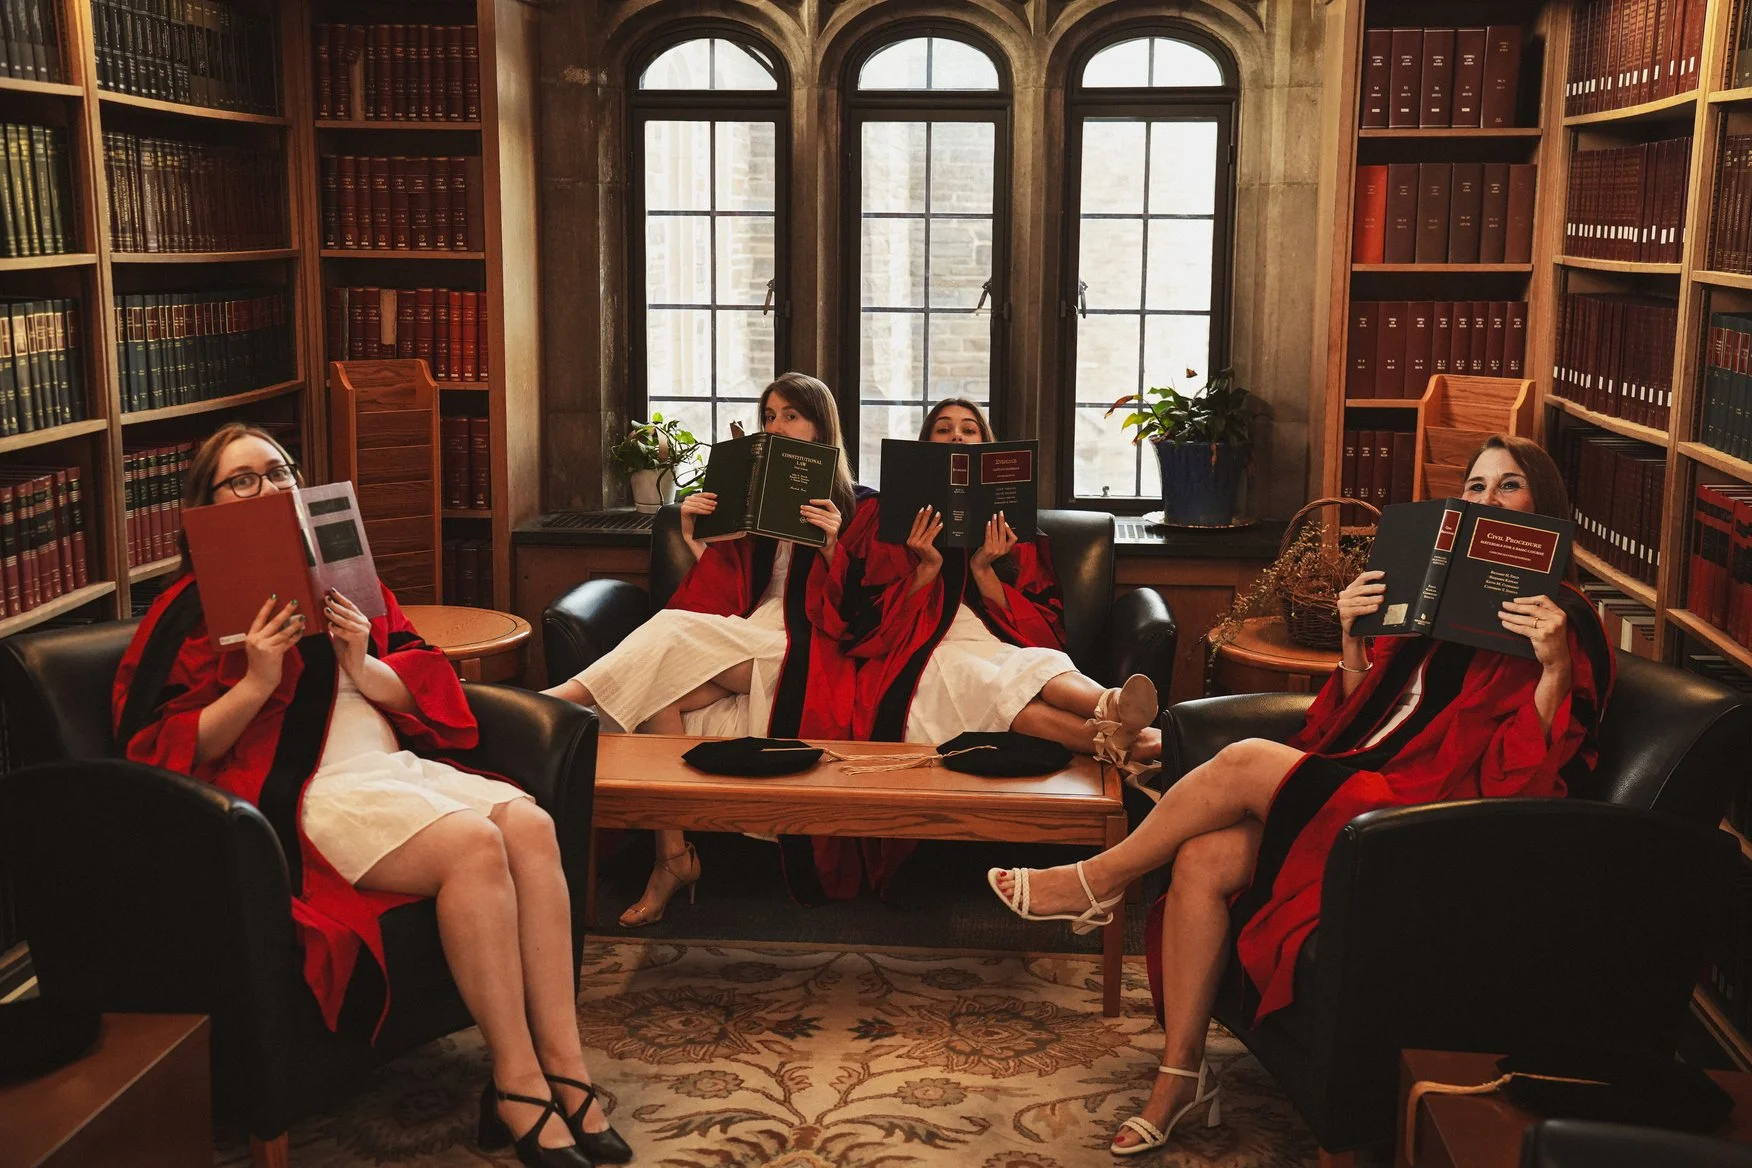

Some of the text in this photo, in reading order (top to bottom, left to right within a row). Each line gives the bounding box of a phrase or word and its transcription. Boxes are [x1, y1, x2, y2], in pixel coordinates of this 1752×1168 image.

[782, 452, 822, 465] CONSTITUTIONAL
[1487, 532, 1542, 548] CIVIL PROCEDURE
